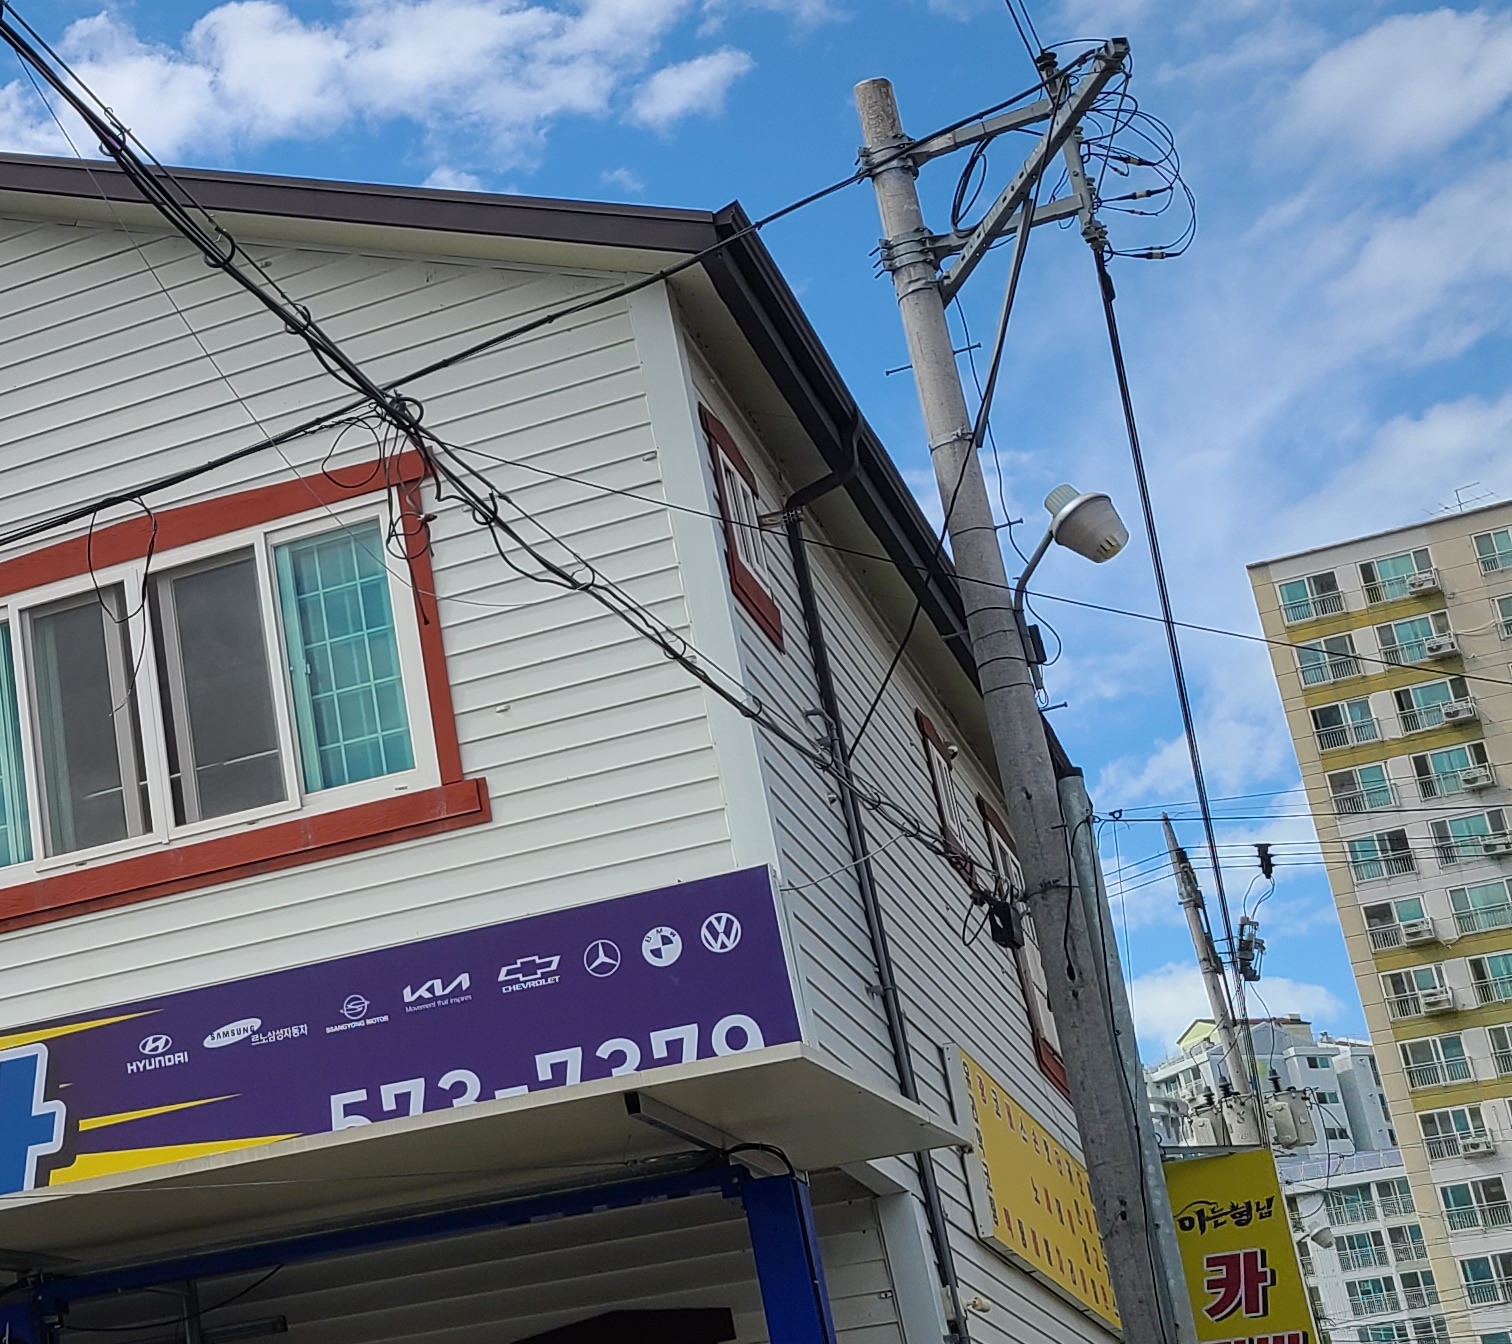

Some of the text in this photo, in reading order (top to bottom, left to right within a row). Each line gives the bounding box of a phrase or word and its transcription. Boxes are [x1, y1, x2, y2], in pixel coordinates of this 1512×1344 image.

[402, 972, 471, 1003] KIA
[502, 975, 561, 994] CHEVROLET
[405, 1001, 436, 1013] Movement
[437, 998, 449, 1007] that
[210, 1024, 256, 1041] SAMSUNG
[325, 1015, 389, 1034] SSANGYONG MOTOR
[126, 1051, 189, 1074] HYUNDAI
[1177, 1195, 1276, 1236] 아는형님
[1202, 1248, 1275, 1321] 카
